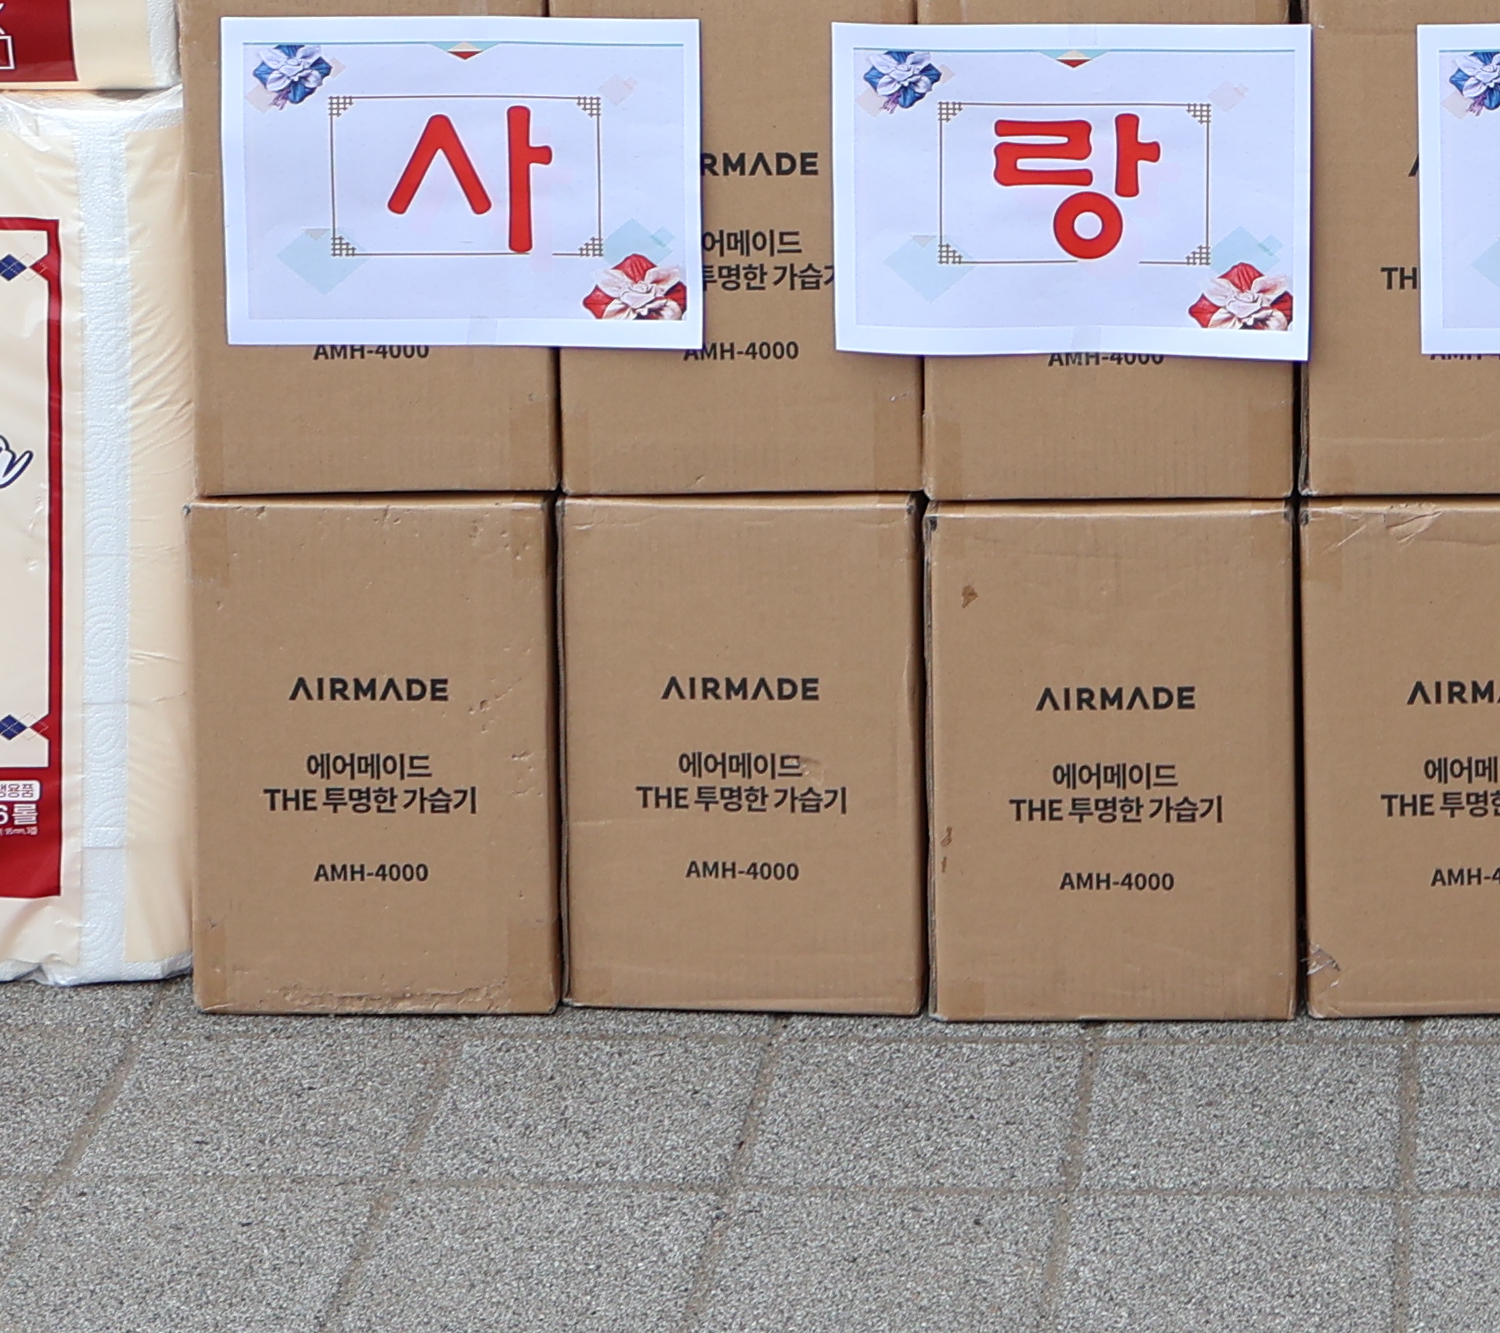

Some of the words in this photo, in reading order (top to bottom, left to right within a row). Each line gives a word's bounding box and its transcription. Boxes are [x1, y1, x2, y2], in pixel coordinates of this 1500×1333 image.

[701, 152, 818, 175] RMADE
[388, 105, 552, 254] 사
[993, 113, 1161, 259] 랑
[702, 230, 802, 257] 어메이드
[313, 345, 429, 359] AMH-4000
[683, 342, 799, 361] AMH-4000
[289, 677, 449, 701] AIRMADE
[661, 676, 819, 701] AIRMADE
[1036, 686, 1195, 711] AIRMADE
[307, 753, 431, 781] 에어메이드
[679, 752, 803, 779] 에어메이드
[1053, 764, 1177, 789] 에어메이드
[264, 788, 317, 812] THE
[322, 787, 397, 814] 투명한
[402, 786, 478, 814] 가습기
[636, 787, 689, 810] THE
[694, 785, 768, 812] 투명한
[774, 785, 848, 814] 가습기
[1009, 798, 1063, 822] THE
[1069, 797, 1143, 824] 투명한
[1149, 796, 1223, 824] 가습기
[1381, 794, 1434, 817] THE
[314, 863, 429, 882] AMH-4000
[686, 861, 799, 881] AMH-4000
[1060, 872, 1174, 891] AMH-4000
